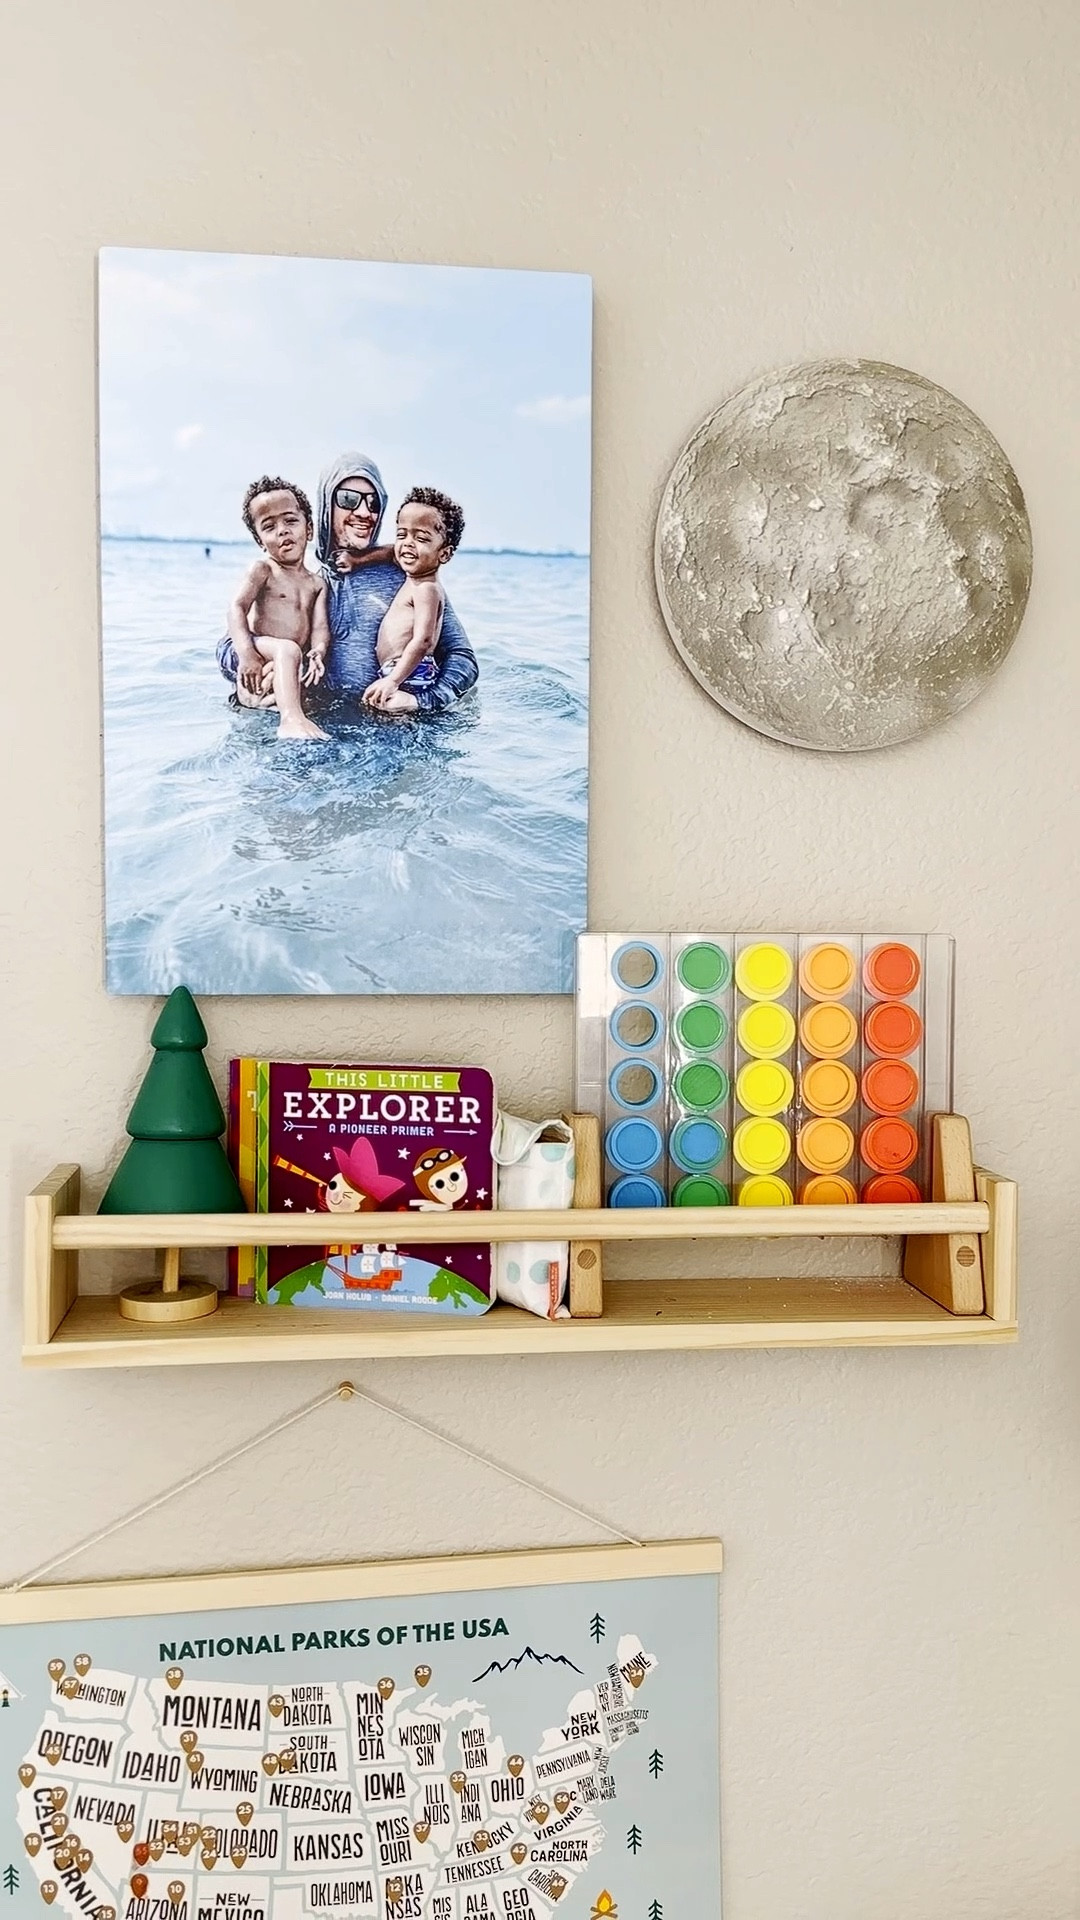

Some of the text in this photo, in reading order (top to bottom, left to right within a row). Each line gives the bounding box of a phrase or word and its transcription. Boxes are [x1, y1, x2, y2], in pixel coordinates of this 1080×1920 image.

[325, 1072, 443, 1089] THIS LITTLE
[283, 1091, 481, 1124] EXPLORER
[329, 1123, 434, 1136] A PIONEER PRIMER
[159, 1617, 510, 1662] NATIONAL PARKS OF THE USA
[50, 1662, 63, 1671] 59
[75, 1657, 89, 1666] 58
[620, 1651, 652, 1683] MAINE
[168, 1670, 181, 1678] 38
[417, 1667, 429, 1676] 35
[630, 1668, 643, 1677] 34
[64, 1680, 77, 1688] 57
[380, 1680, 392, 1689] 36
[291, 1686, 323, 1703] NORTH
[269, 1698, 282, 1706] 43
[356, 1692, 384, 1715] MIN
[162, 1695, 261, 1731] MONTANA
[283, 1704, 332, 1727] DAKOTA
[571, 1710, 597, 1725] NEW
[358, 1714, 384, 1738] NES
[561, 1721, 600, 1741] YORK
[183, 1734, 194, 1742] 31
[399, 1723, 441, 1747] WISCON
[461, 1728, 485, 1749] MICH
[290, 1735, 328, 1751] SOUTH
[358, 1738, 385, 1761] OTA
[47, 1746, 60, 1755] 45
[416, 1745, 435, 1767] SIN
[190, 1754, 201, 1762] 61
[464, 1748, 488, 1769] IGAN
[536, 1749, 591, 1779] PENNSYLVANIA
[20, 1768, 33, 1777] 19
[122, 1751, 181, 1782] IDAHO
[191, 1767, 259, 1793] WYOMING
[452, 1773, 465, 1782] 32
[576, 1775, 595, 1792] MARY
[365, 1772, 406, 1801] IOWA
[491, 1777, 524, 1802] OHIO
[53, 1791, 65, 1799] 17
[269, 1783, 352, 1815] NEBRASKA
[425, 1783, 445, 1805] ILLI
[556, 1794, 569, 1803] 56
[74, 1795, 136, 1825] NEVADA
[238, 1806, 251, 1814] 25
[423, 1804, 450, 1826] NOIS
[461, 1804, 482, 1823] ANA
[534, 1805, 547, 1814] 60
[54, 1817, 65, 1825] 21
[534, 1805, 583, 1841] VIRGINIA
[119, 1824, 132, 1832] 39
[163, 1824, 177, 1832] 54
[187, 1826, 198, 1834] 51
[202, 1830, 216, 1839] 22
[376, 1817, 410, 1843] MISS
[416, 1824, 428, 1832] 37
[27, 1837, 39, 1846] 18
[66, 1838, 77, 1847] 16
[179, 1837, 191, 1845] 53
[476, 1832, 489, 1841] 33
[150, 1842, 163, 1850] 52
[294, 1833, 363, 1861] KANSAS
[552, 1840, 588, 1850] NORTH
[56, 1848, 70, 1857] 20
[79, 1853, 90, 1862] 14
[202, 1850, 216, 1859] 24
[232, 1848, 246, 1857] 23
[380, 1839, 412, 1866] OURI
[530, 1850, 588, 1862] CAROLINA
[445, 1856, 505, 1883] TENNESSEE
[43, 1885, 55, 1893] 13
[171, 1885, 182, 1893] 10
[311, 1880, 373, 1907] OKLAHOMA
[390, 1883, 400, 1892] 12
[216, 1893, 250, 1906] NEW
[433, 1896, 452, 1914] MIS
[467, 1893, 488, 1914] ALA
[503, 1887, 529, 1911] GEO
[101, 1910, 113, 1919] 15
